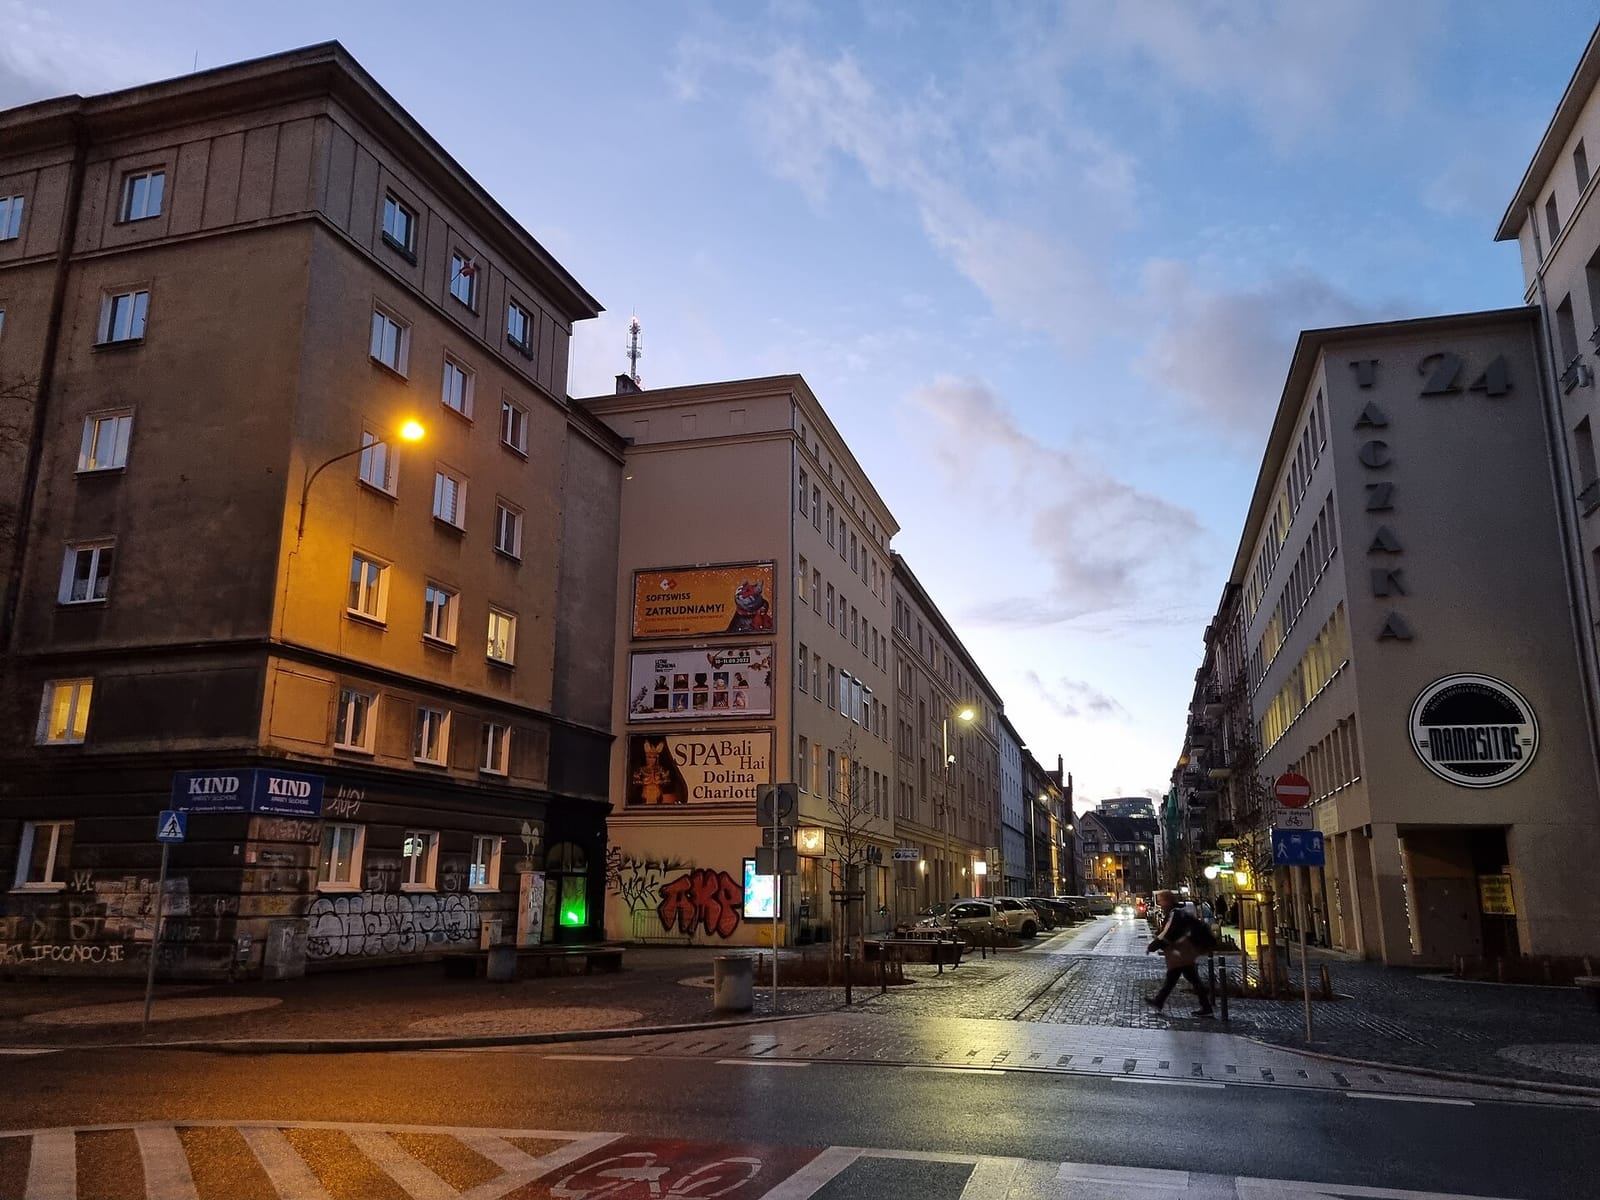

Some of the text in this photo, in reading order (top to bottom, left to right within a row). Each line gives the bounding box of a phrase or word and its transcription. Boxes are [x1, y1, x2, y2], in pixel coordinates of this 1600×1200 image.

[1418, 351, 1512, 398] 24
[1350, 358, 1413, 642] TACZAKA
[645, 591, 691, 602] SOFTSWISS
[645, 603, 725, 617] ZATRUDNIAMY!
[673, 740, 752, 768] SPA Bali
[1428, 727, 1523, 762] MAMASITAS
[739, 755, 765, 770] Hai
[187, 776, 240, 795] KIND
[703, 770, 755, 784] Dolina
[267, 777, 311, 798] KIND
[692, 785, 757, 800] Charlott
